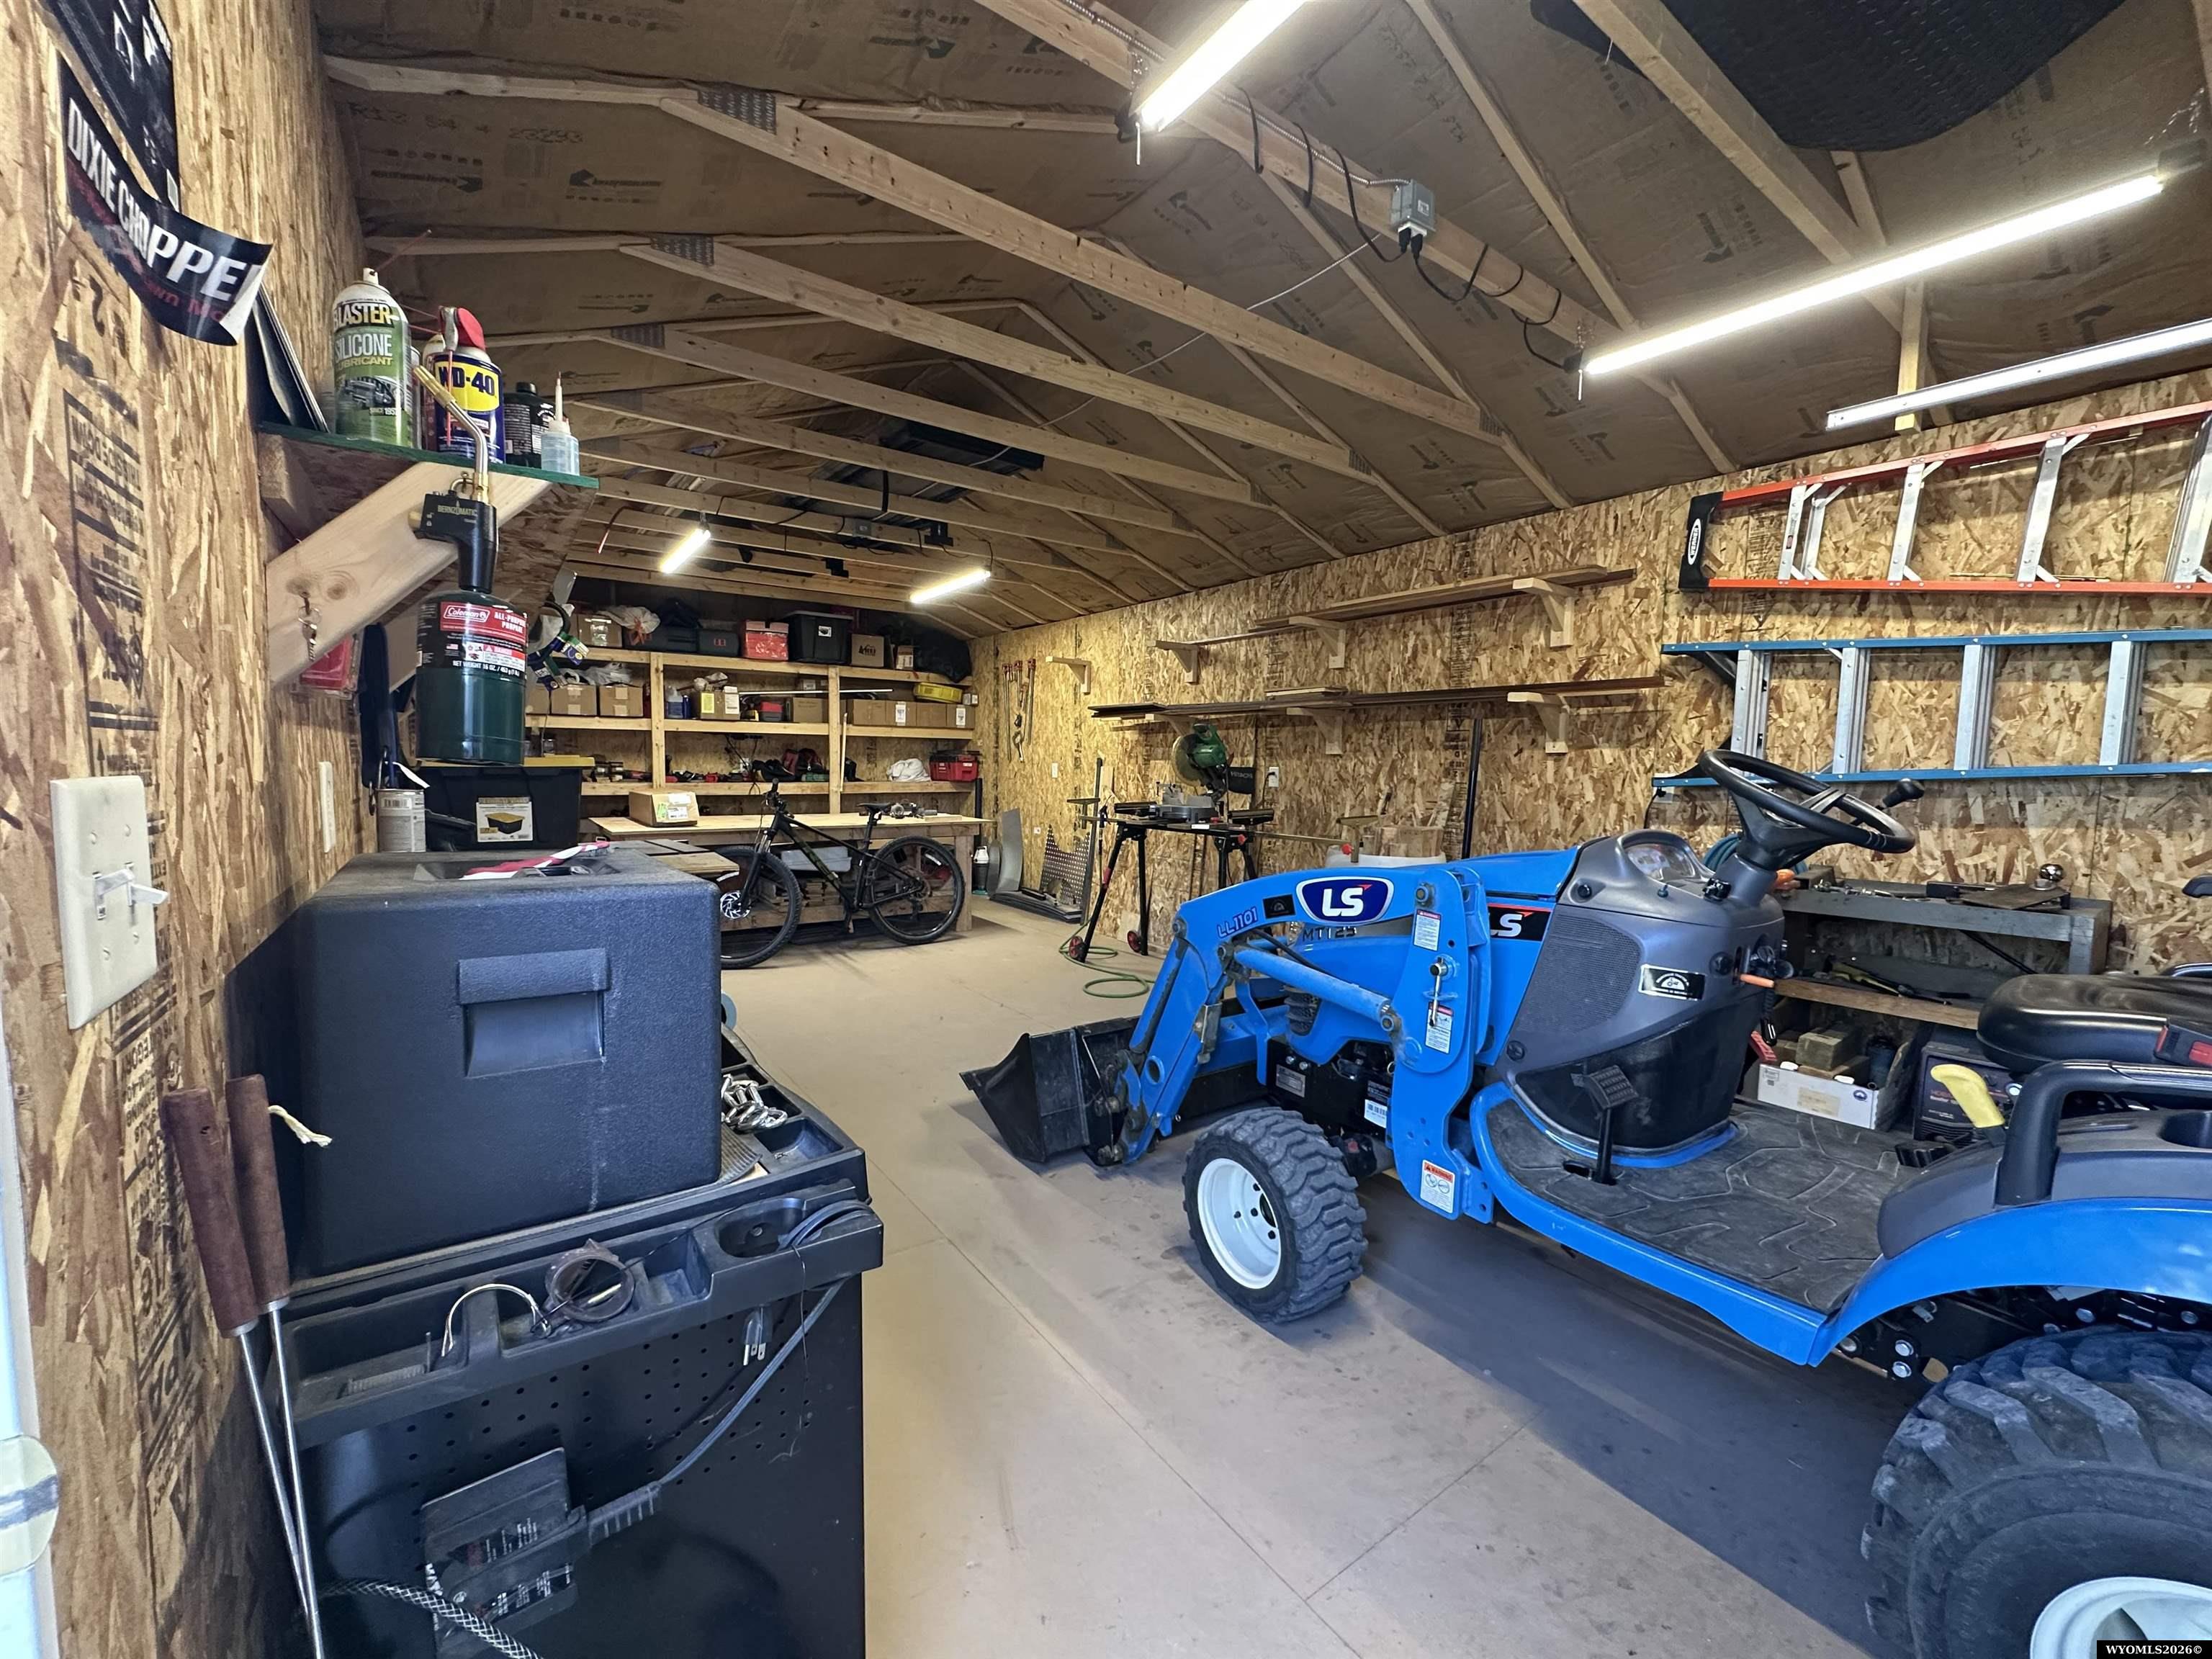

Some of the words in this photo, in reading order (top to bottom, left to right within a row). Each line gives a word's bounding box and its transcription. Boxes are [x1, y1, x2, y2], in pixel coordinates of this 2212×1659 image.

[68, 97, 116, 214] DIXIE
[117, 179, 265, 302] CHOPPE
[335, 333, 393, 363] SILICONE
[439, 367, 495, 397] WD-40
[447, 606, 480, 619] Coleman
[1321, 886, 1364, 917] LS
[1217, 907, 1258, 938] LL1101
[1488, 912, 1523, 938] S
